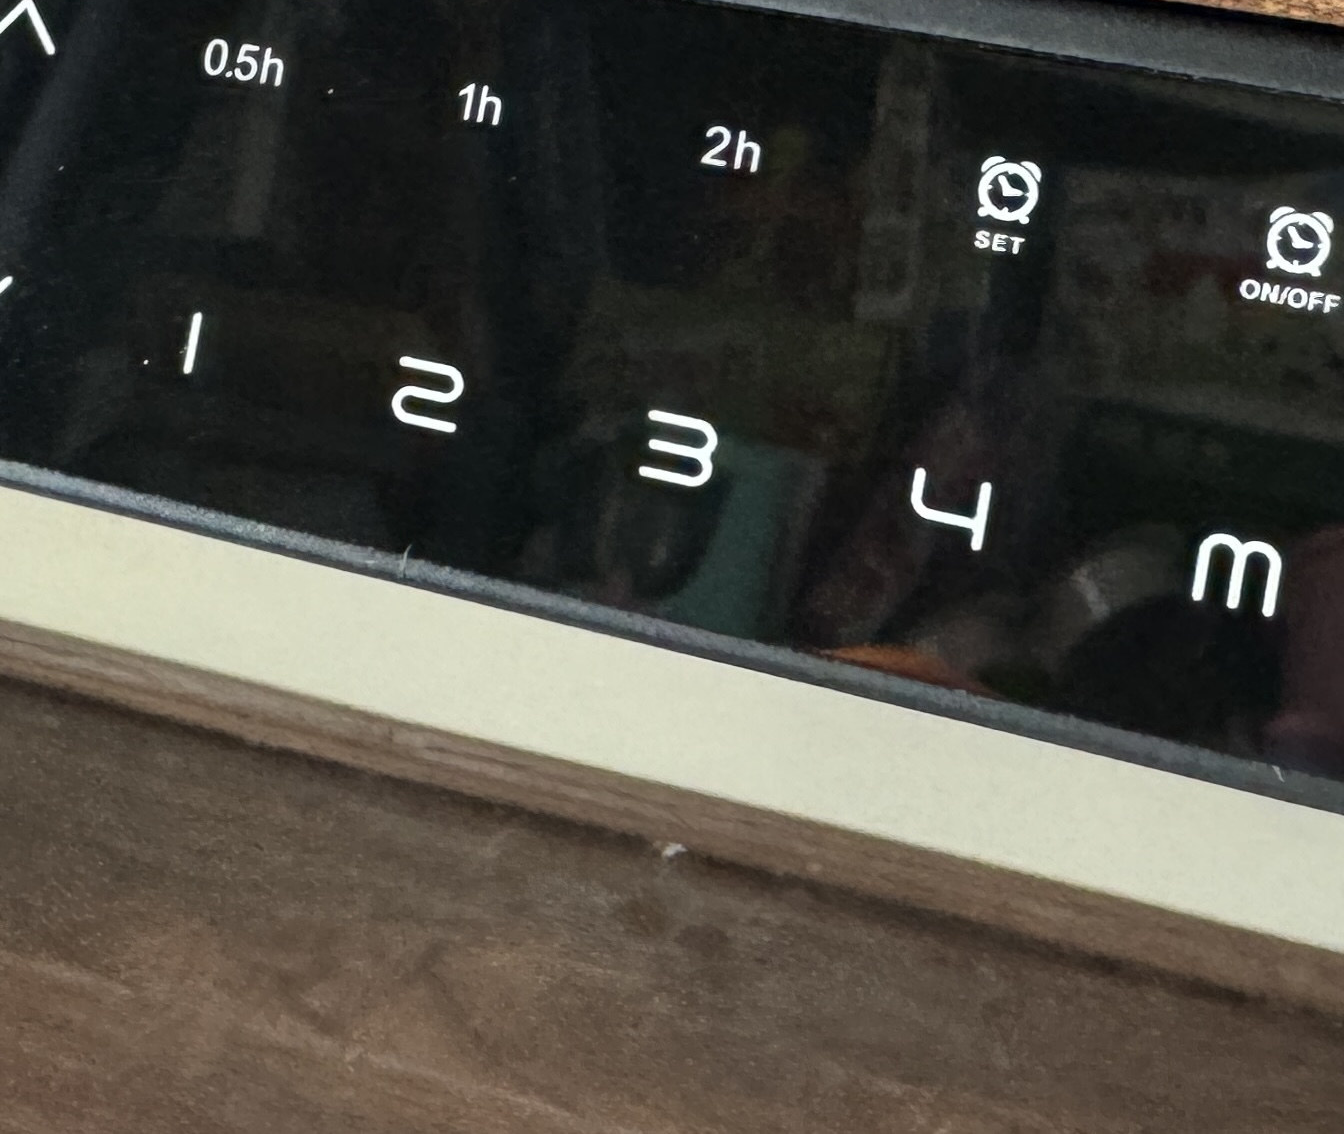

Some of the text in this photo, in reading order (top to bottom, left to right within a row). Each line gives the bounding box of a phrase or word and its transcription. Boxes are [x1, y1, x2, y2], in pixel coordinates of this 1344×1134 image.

[204, 38, 285, 87] 0.5h
[458, 82, 502, 126] 1h
[700, 125, 761, 173] 2h
[973, 229, 1026, 255] SET
[1238, 278, 1342, 314] ON/OFF
[183, 311, 203, 375] 1
[391, 355, 465, 434] 2
[638, 409, 719, 488] 3
[910, 467, 993, 552] 4
